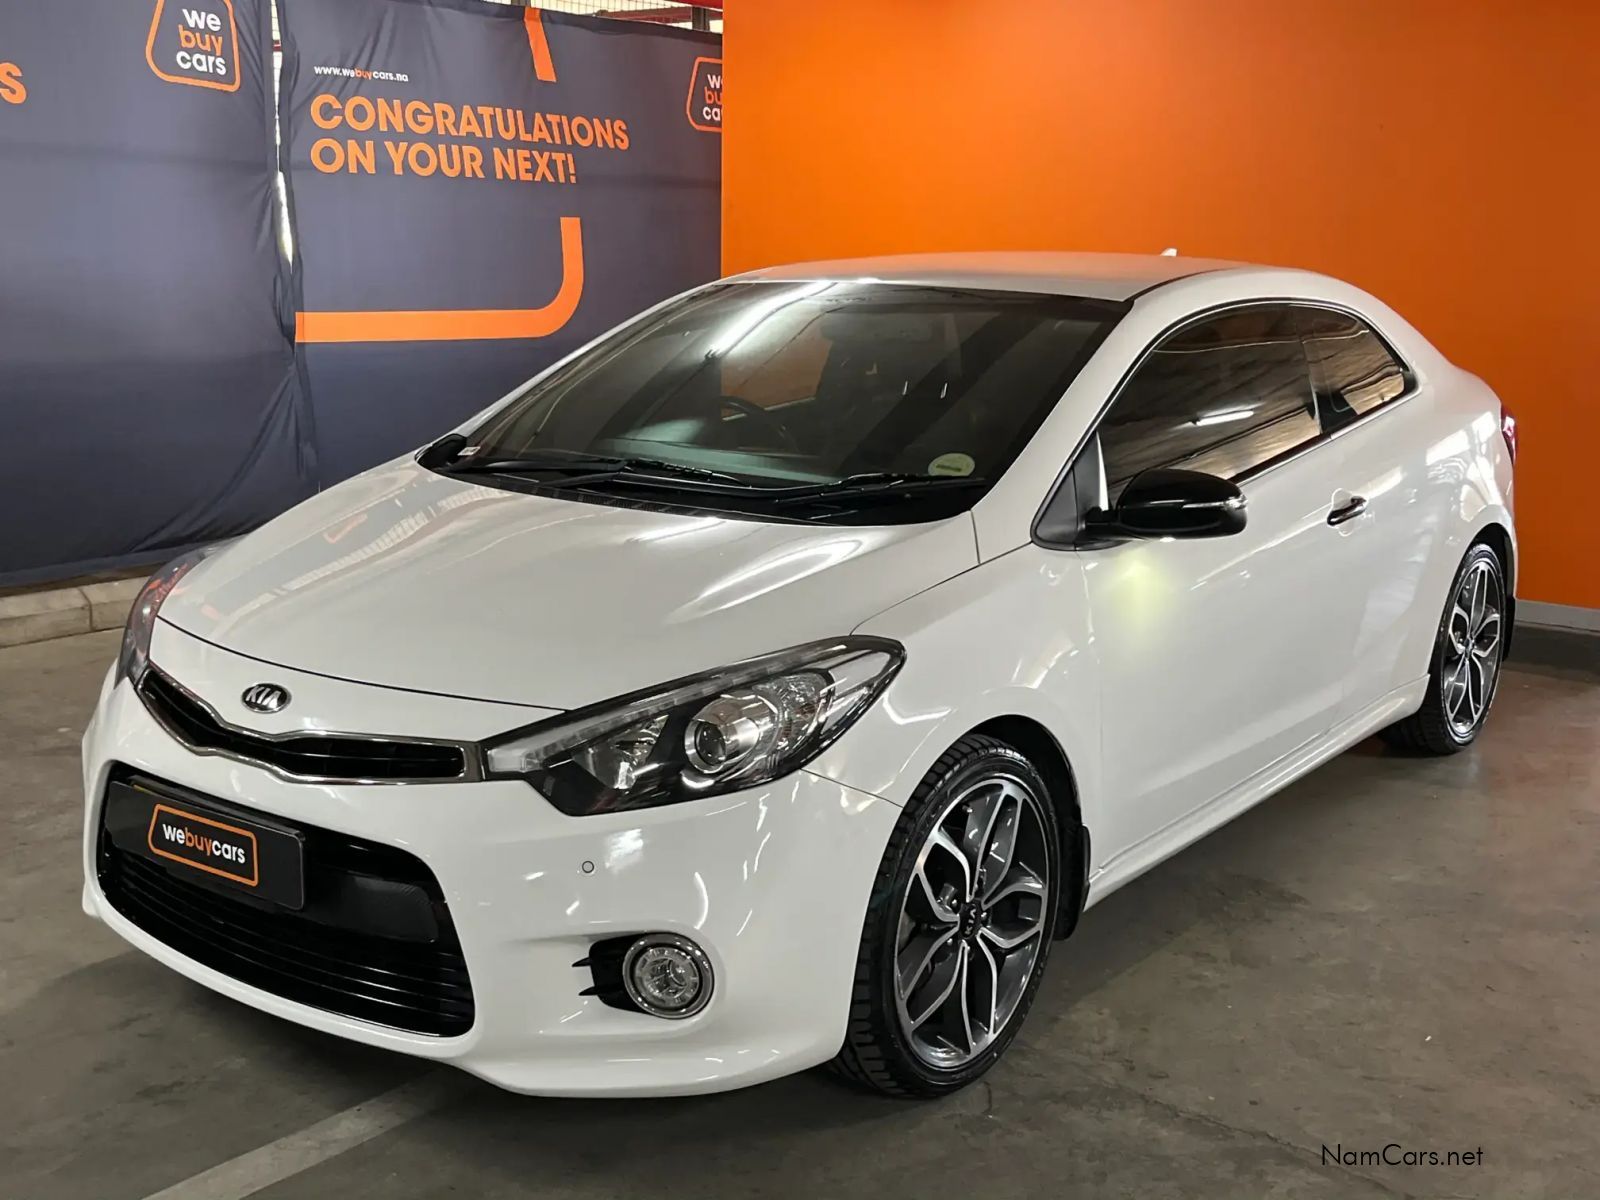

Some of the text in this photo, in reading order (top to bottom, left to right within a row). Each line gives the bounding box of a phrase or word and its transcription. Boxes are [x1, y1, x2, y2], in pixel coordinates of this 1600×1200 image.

[182, 8, 222, 32] we
[178, 24, 223, 57] buy
[176, 50, 227, 76] cars
[313, 65, 409, 82] www.webuycars.na
[707, 73, 723, 89] w
[310, 94, 630, 150] CONGRATULATIONS
[310, 138, 577, 184] ON YOUR NEXT!
[245, 685, 281, 709] KIA
[162, 823, 246, 864] webuycars
